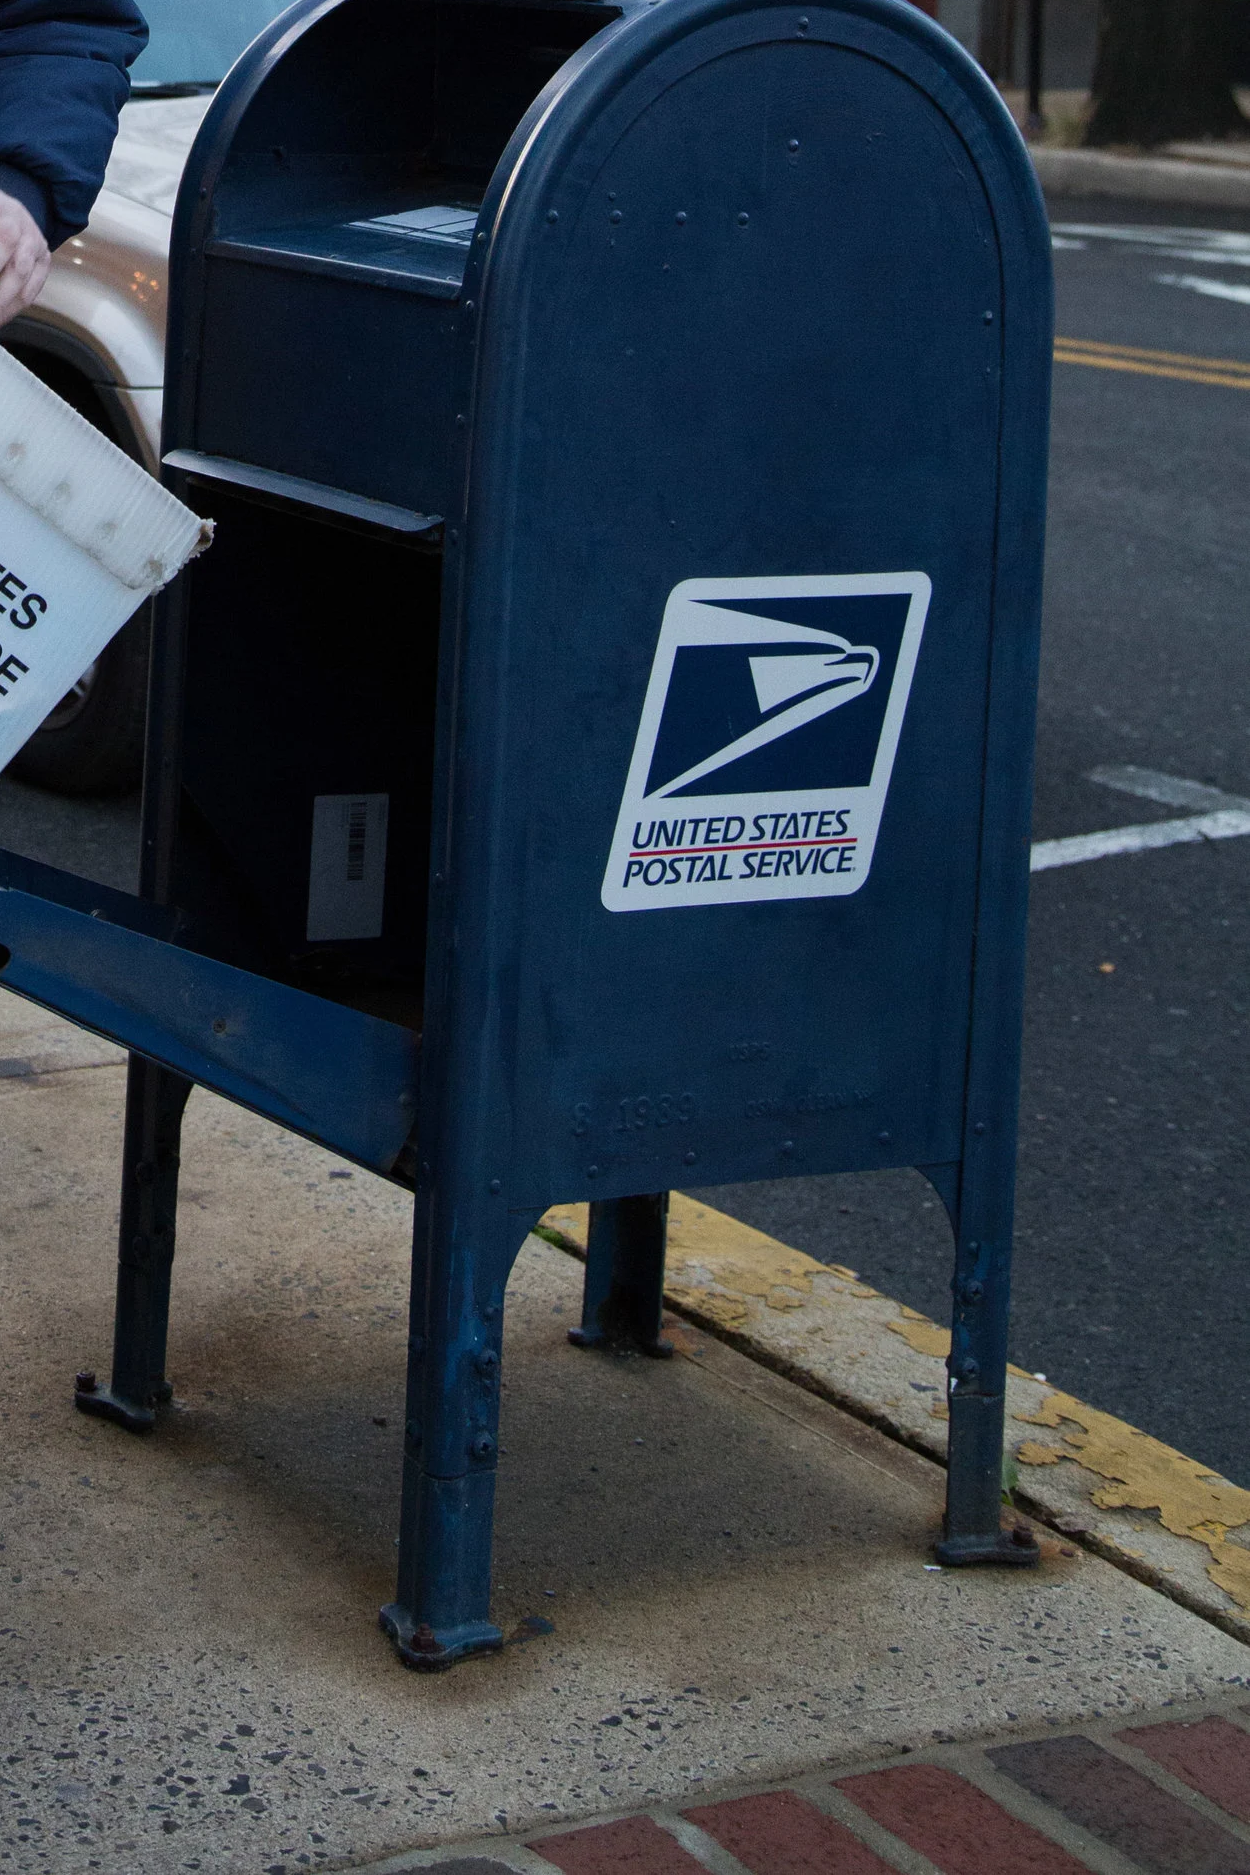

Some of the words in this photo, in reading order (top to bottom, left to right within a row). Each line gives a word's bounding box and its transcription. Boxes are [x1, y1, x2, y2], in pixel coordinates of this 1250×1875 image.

[632, 815, 746, 850] UNITED
[749, 809, 851, 841] STATES
[622, 854, 733, 888] POSTAL
[739, 845, 857, 880] SERVICE
